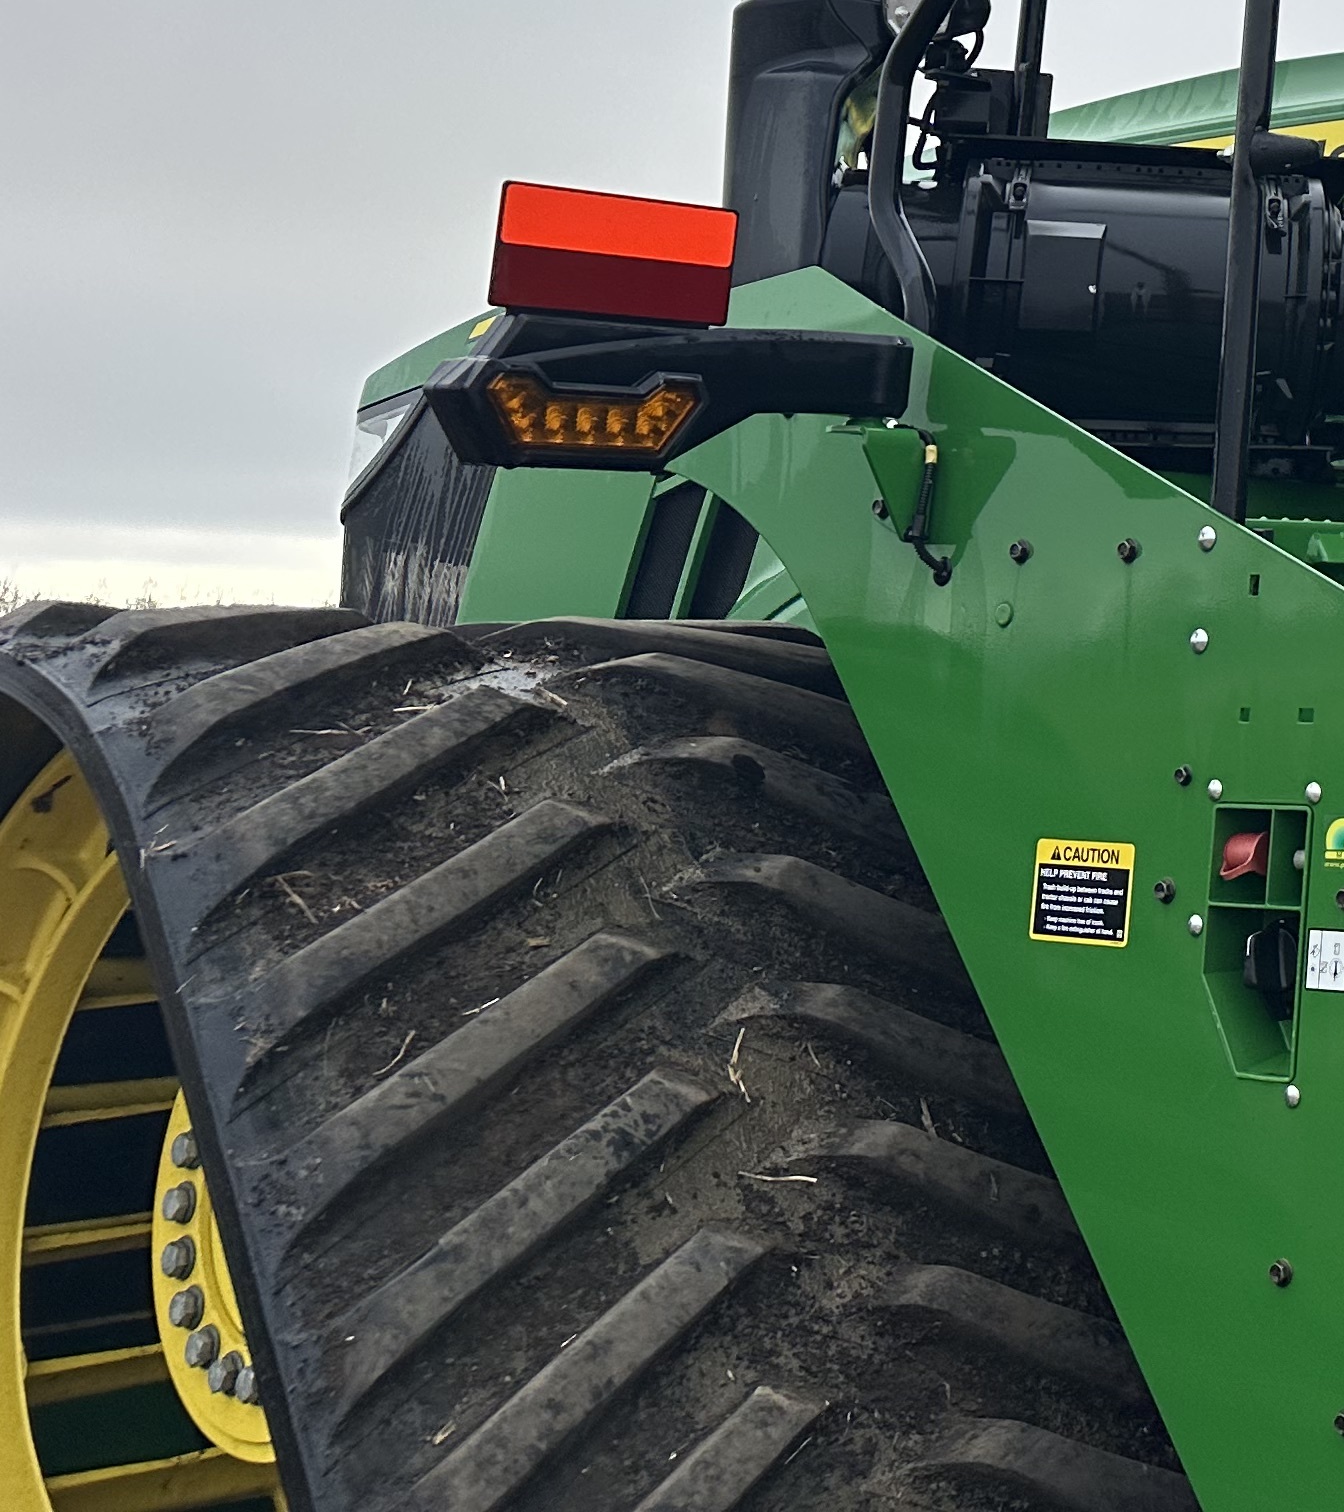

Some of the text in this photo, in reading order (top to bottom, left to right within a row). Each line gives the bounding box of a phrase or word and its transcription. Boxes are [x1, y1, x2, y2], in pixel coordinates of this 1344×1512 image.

[1063, 846, 1120, 865] CAUTION
[1040, 867, 1108, 882] HELP PREVENT FIRE
